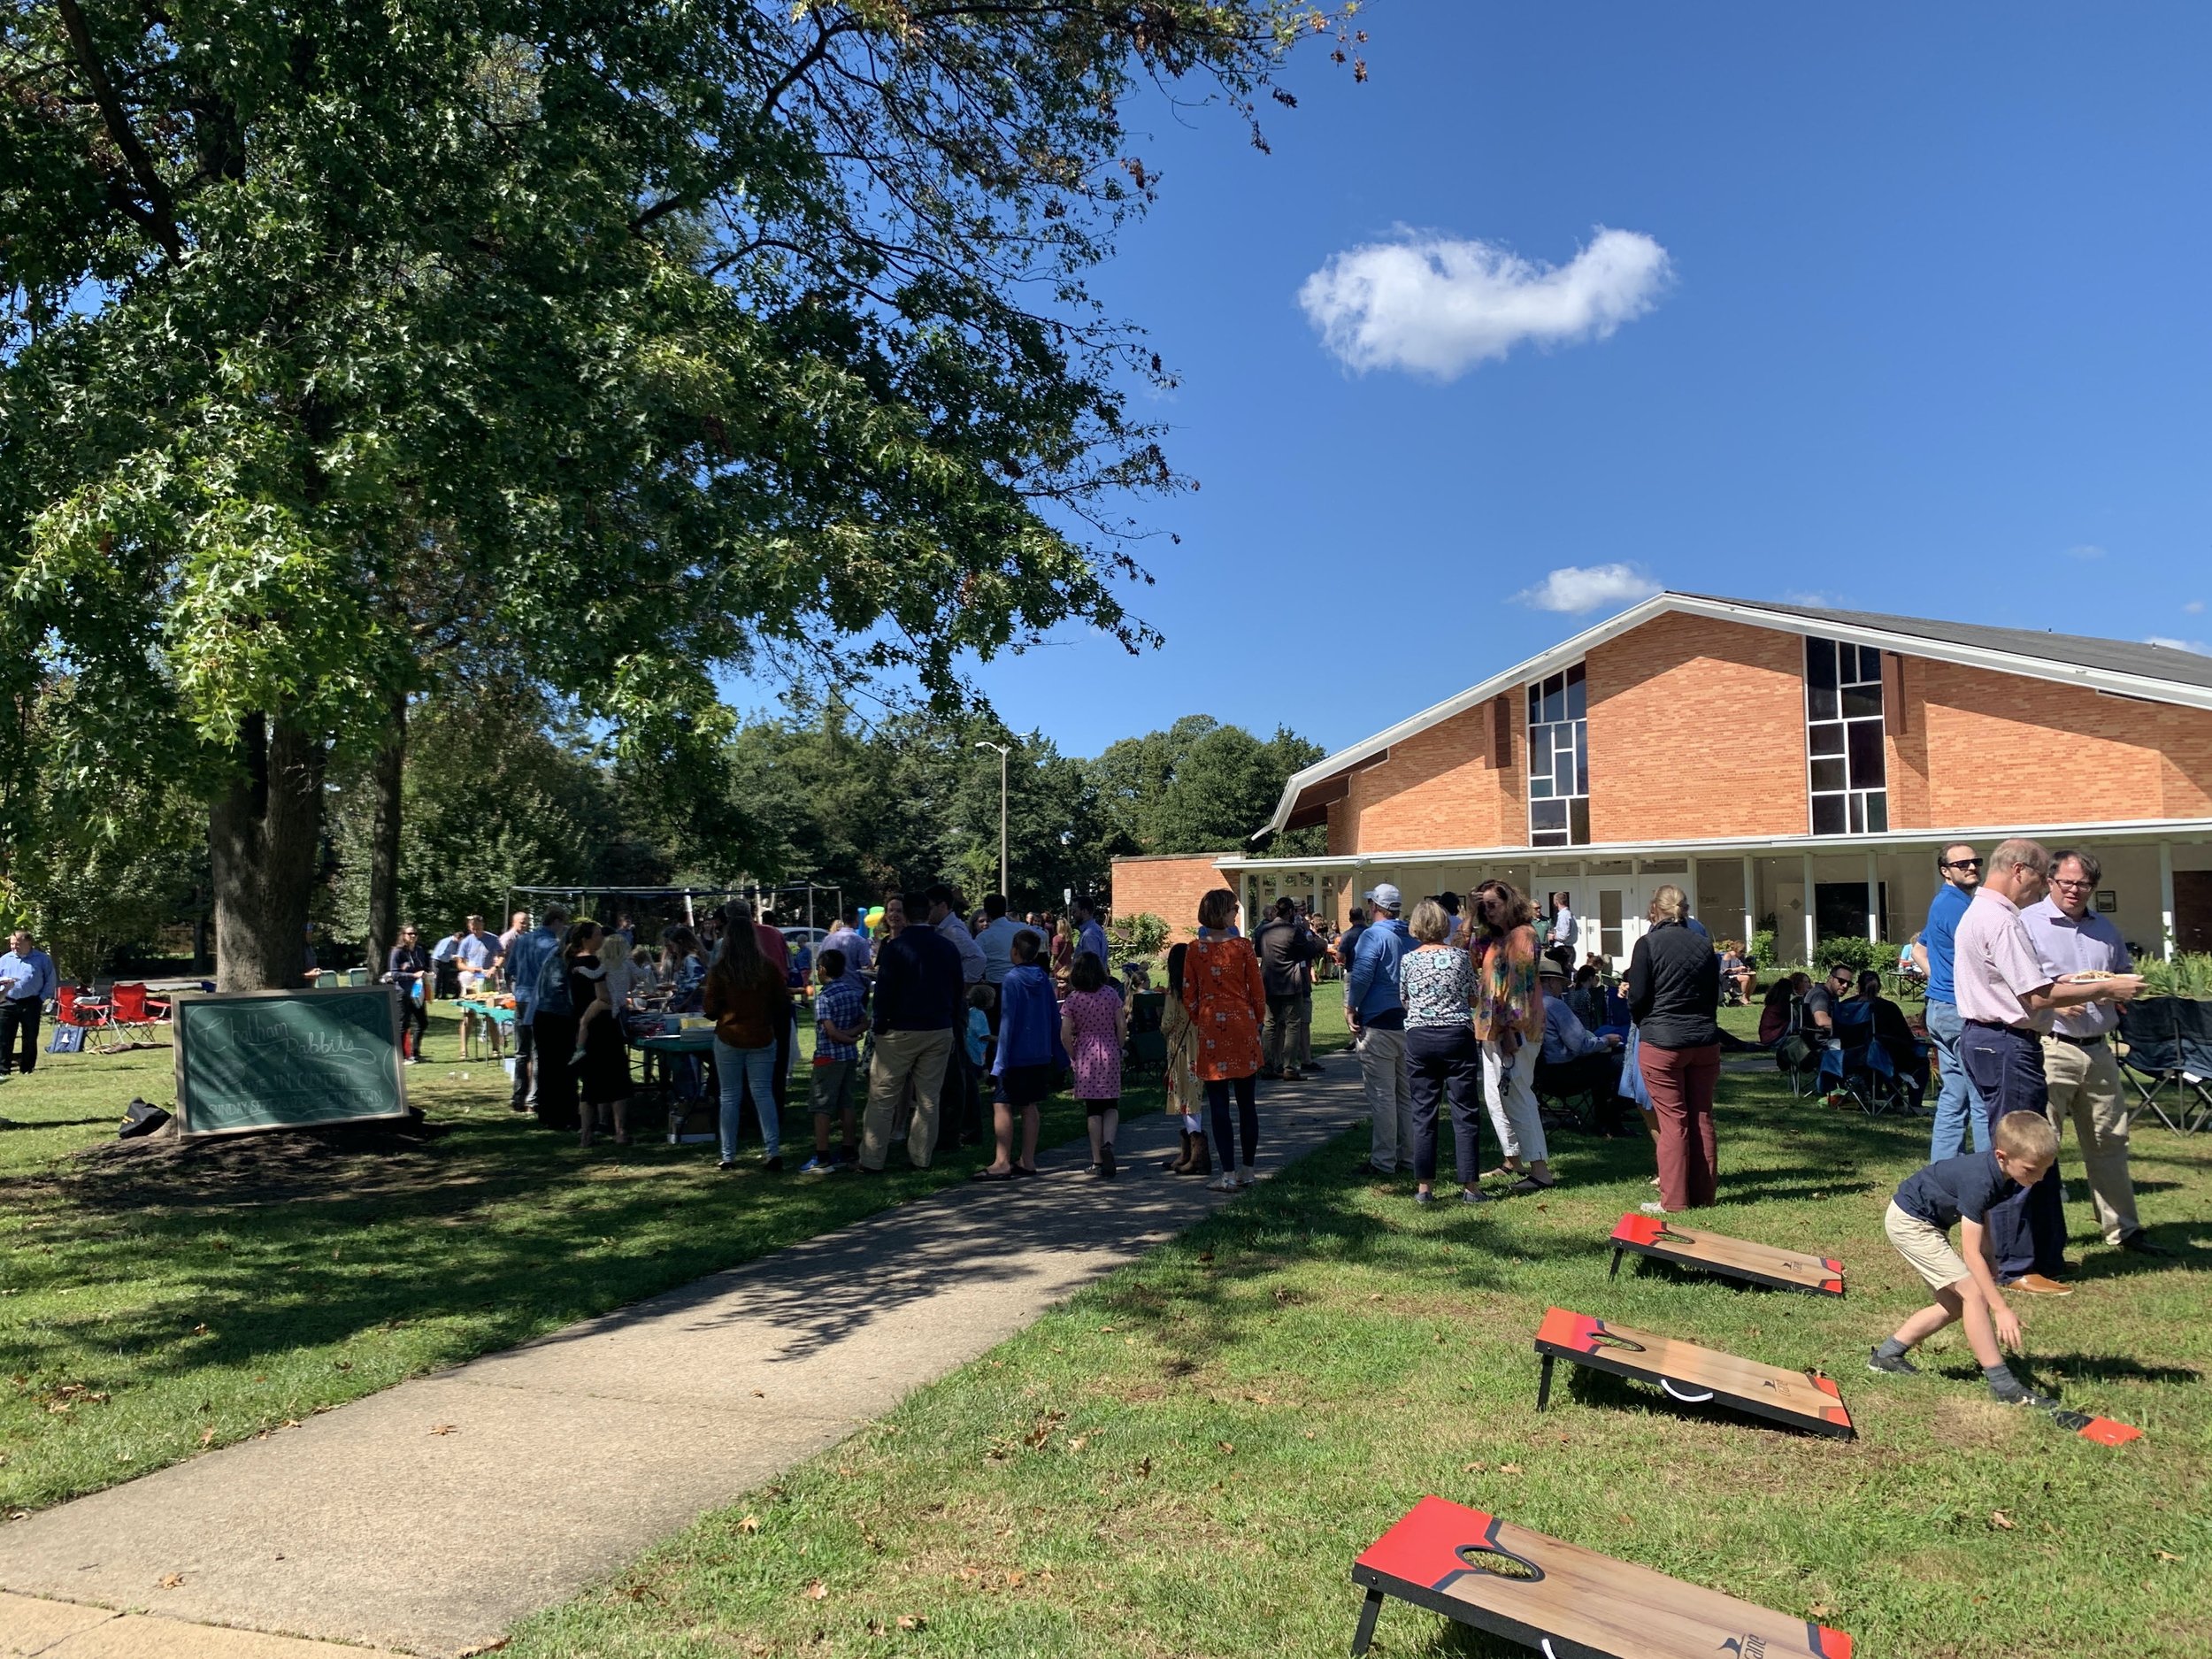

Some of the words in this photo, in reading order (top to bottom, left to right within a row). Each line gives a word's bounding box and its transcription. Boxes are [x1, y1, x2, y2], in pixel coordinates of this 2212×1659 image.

[197, 1013, 288, 1053] Chatham
[282, 1029, 363, 1063] Rabbits
[274, 1071, 292, 1091] IN
[208, 1101, 248, 1116] SUNDAY
[353, 1088, 383, 1105] LAWN
